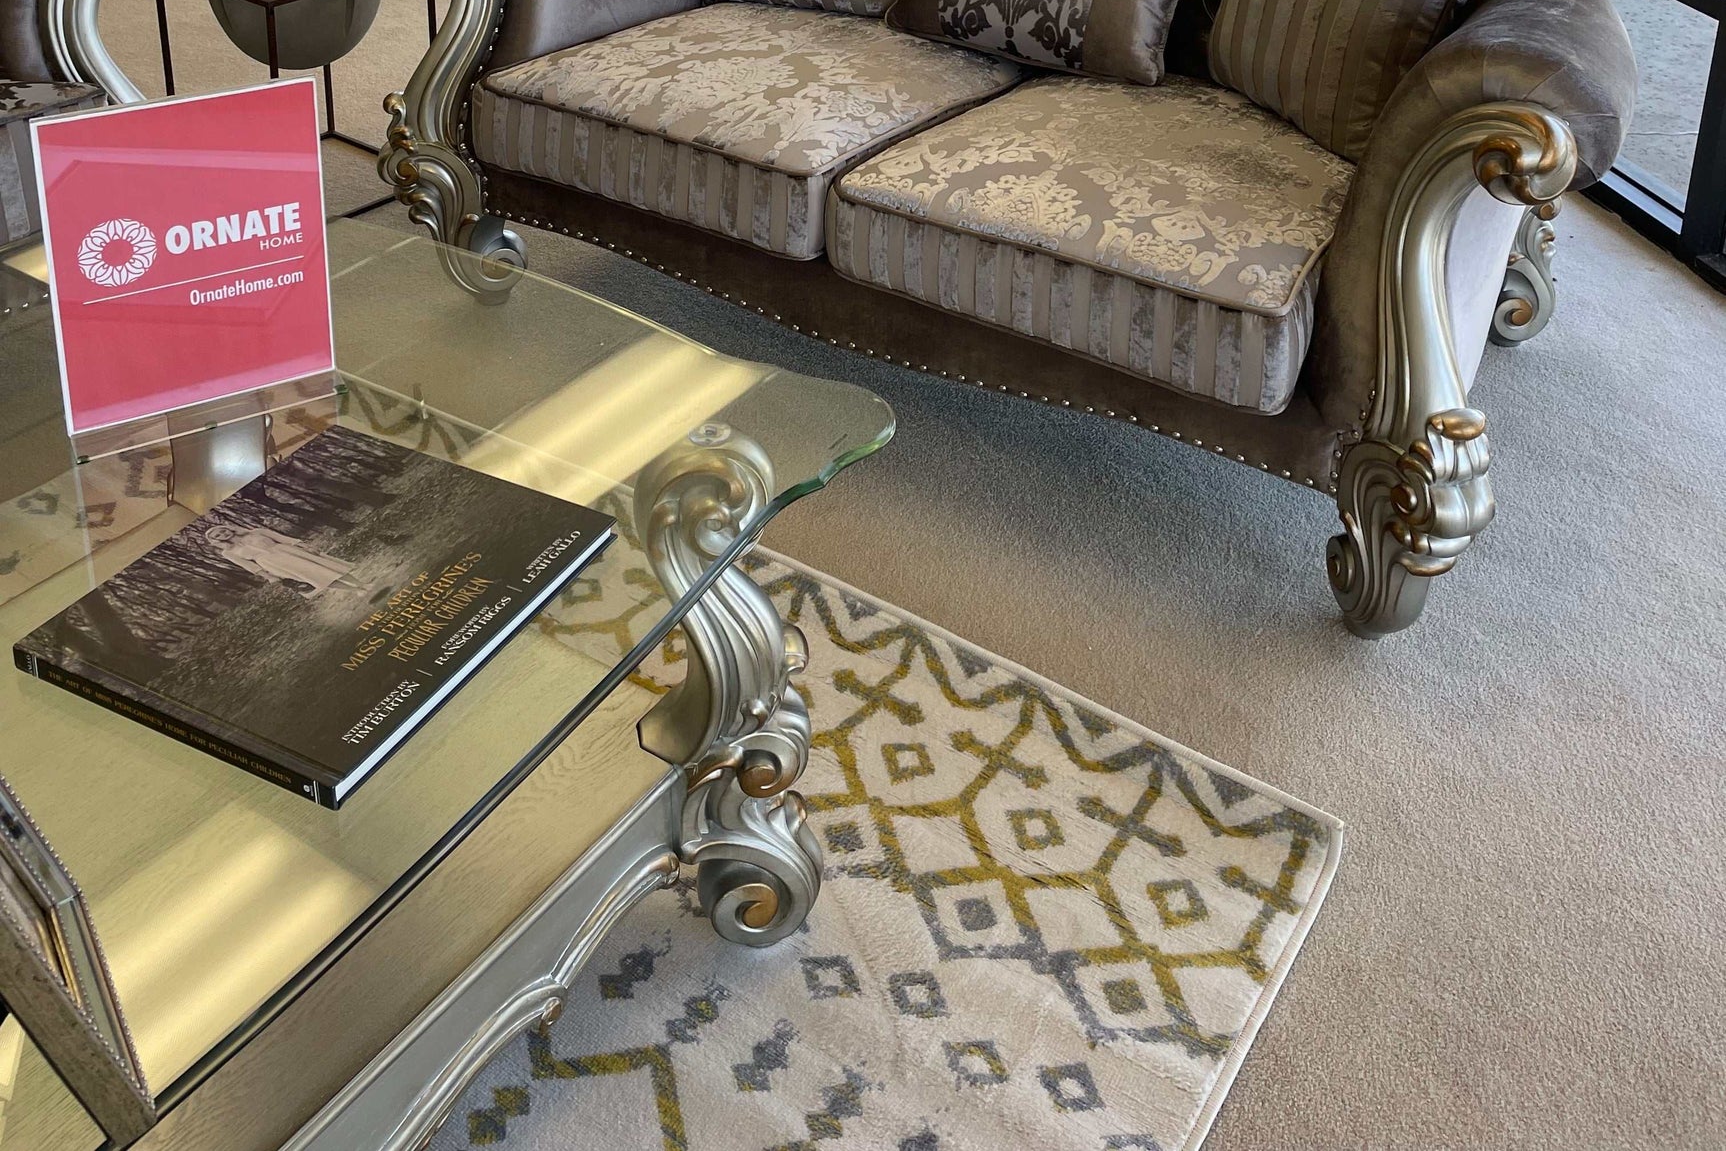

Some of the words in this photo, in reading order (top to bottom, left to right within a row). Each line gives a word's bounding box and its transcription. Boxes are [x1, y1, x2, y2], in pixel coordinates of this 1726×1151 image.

[165, 202, 301, 255] ORNATE
[260, 232, 303, 251] HOME
[190, 271, 304, 305] OrnateHome.com
[522, 558, 551, 584] LEAH
[548, 530, 581, 559] GALLO
[526, 546, 555, 570] WRITTEN
[552, 537, 563, 546] BY
[340, 636, 386, 671] MISS
[381, 552, 482, 635] PEREGRINE'S
[356, 610, 388, 631] THE
[387, 588, 412, 610] ART
[411, 571, 429, 587] OF
[388, 619, 449, 662] PECULIAR
[435, 577, 494, 620] CHILDREN
[441, 614, 480, 650] FOREWORD
[479, 604, 490, 615] BY
[434, 624, 482, 666] RANSOM
[478, 596, 512, 625] RIGGS
[341, 689, 400, 741] INTRODUCTION
[397, 679, 410, 691] BY
[347, 724, 374, 744] TIM
[370, 681, 420, 725] BURTON
